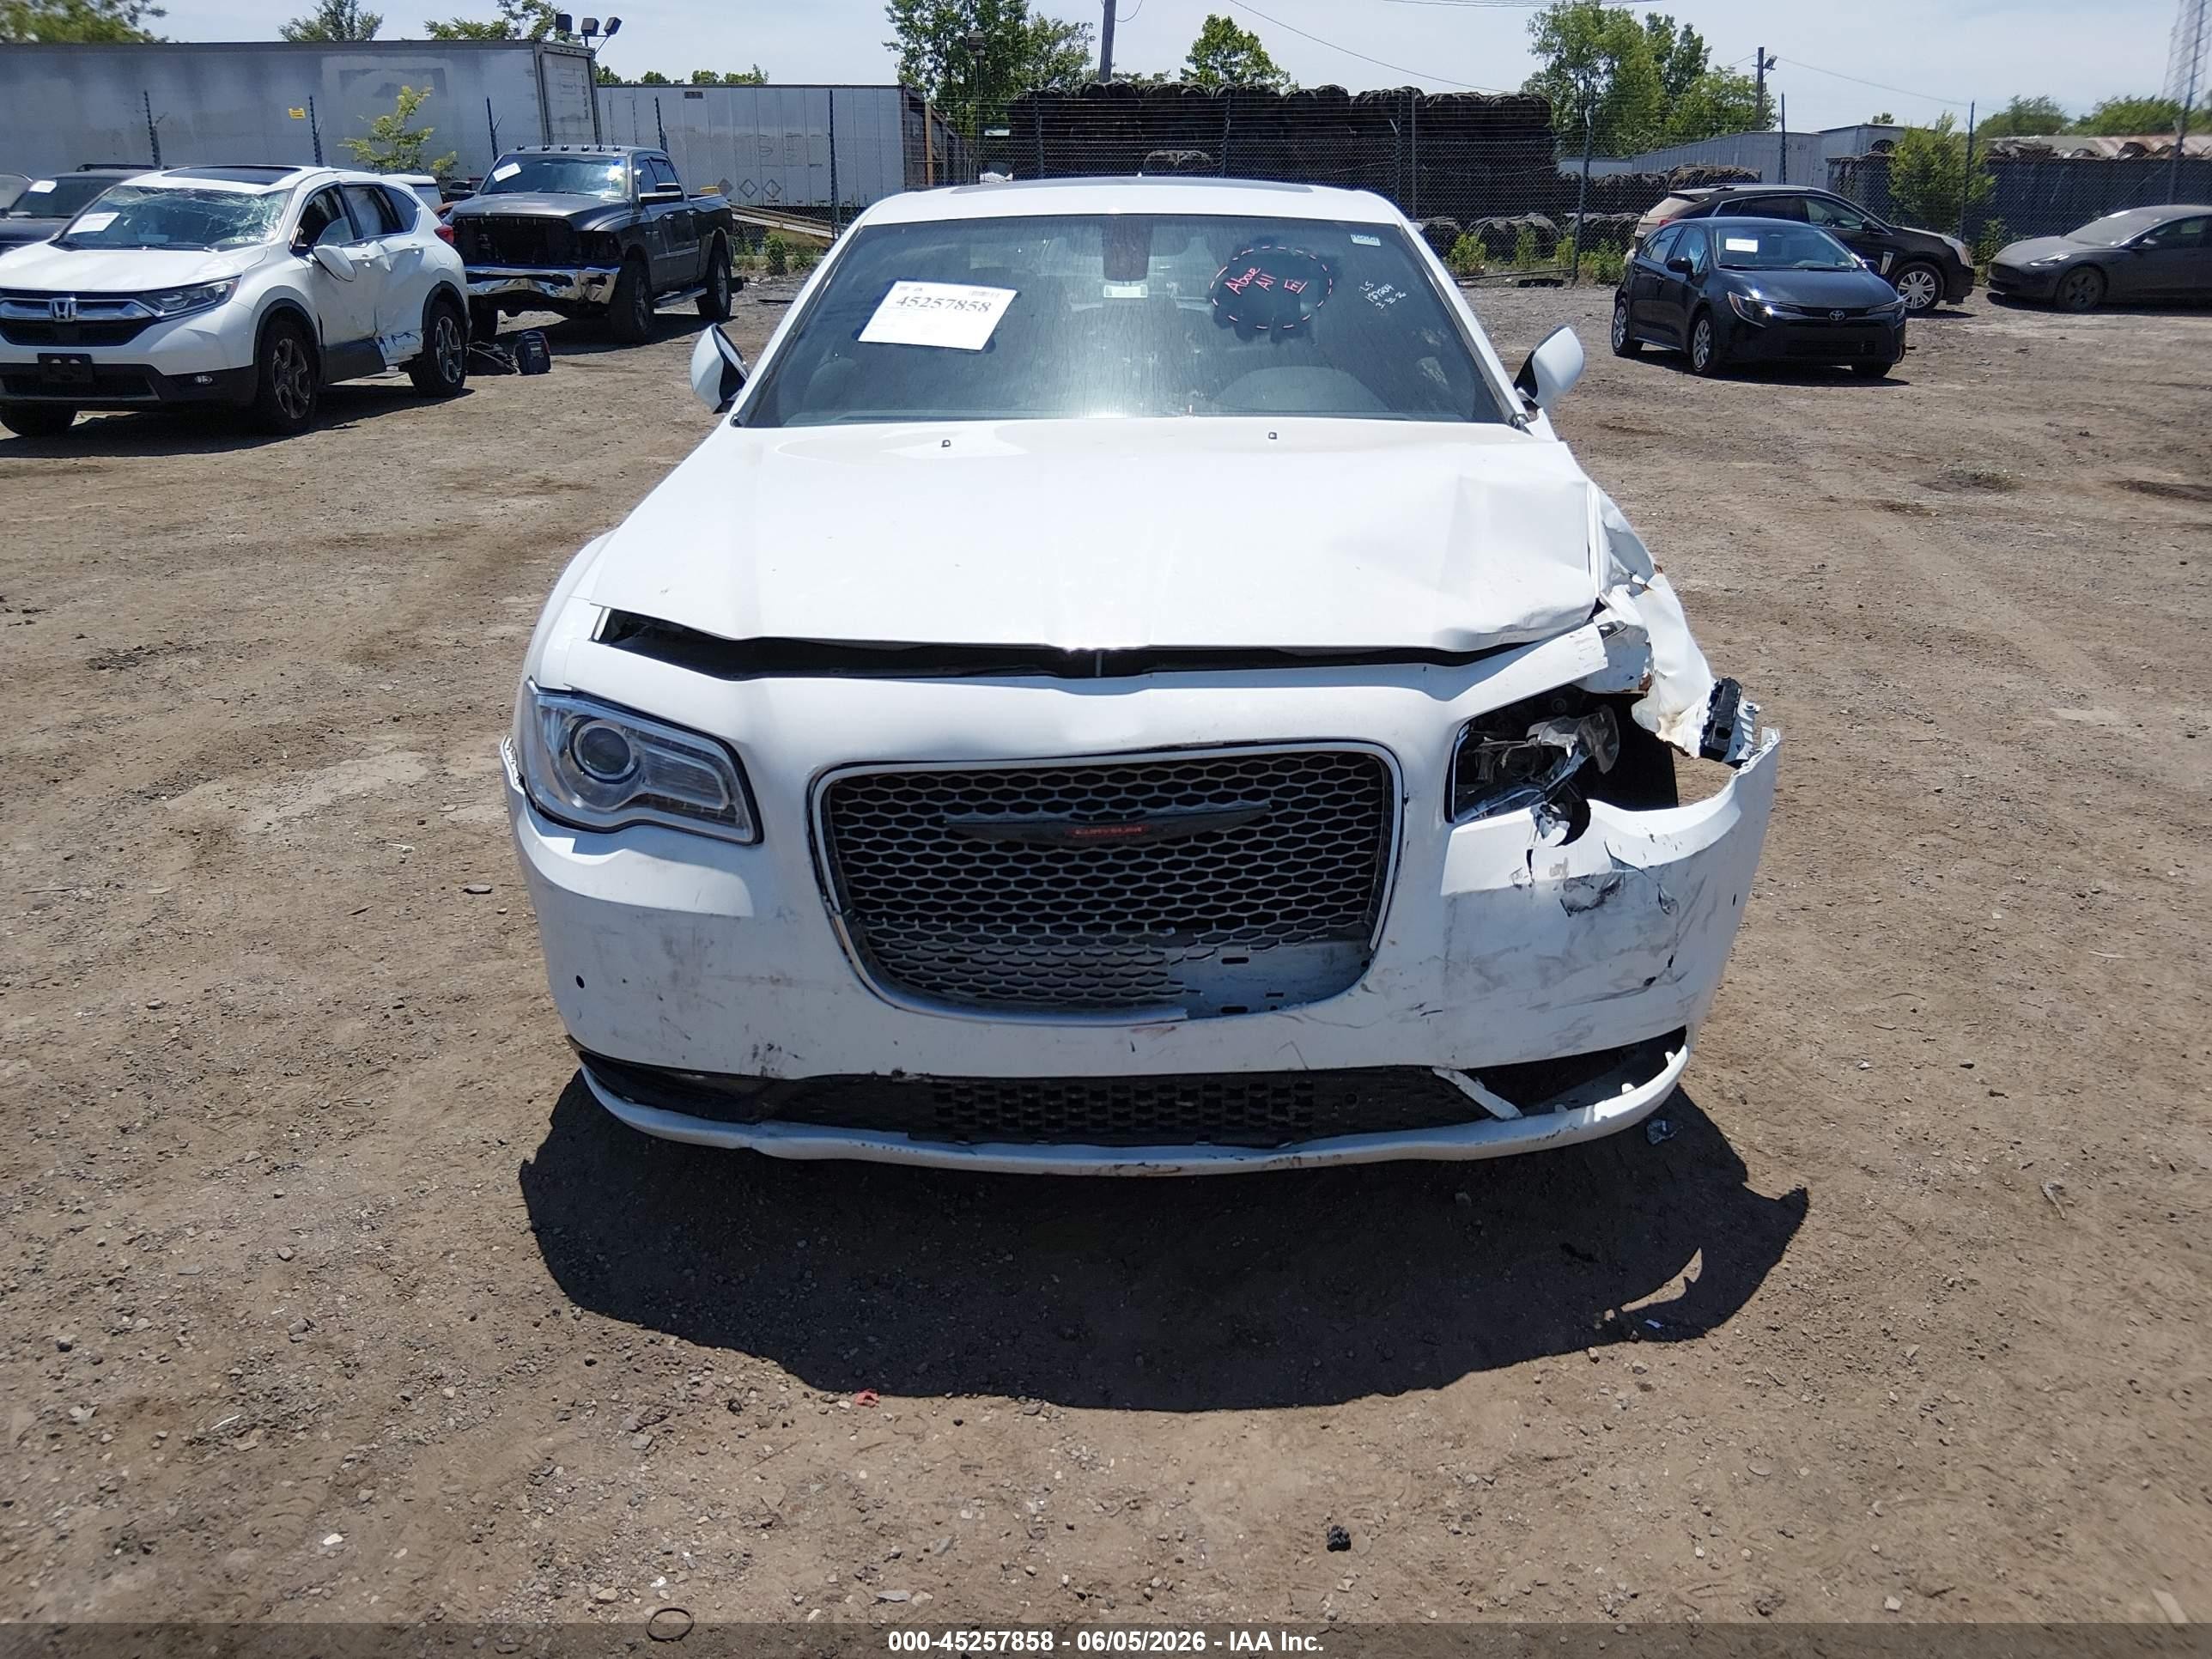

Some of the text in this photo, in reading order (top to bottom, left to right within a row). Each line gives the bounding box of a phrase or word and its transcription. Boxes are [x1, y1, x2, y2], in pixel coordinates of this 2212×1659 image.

[1224, 267, 1261, 295] Above
[1255, 273, 1277, 292] All
[896, 295, 992, 313] 45257858
